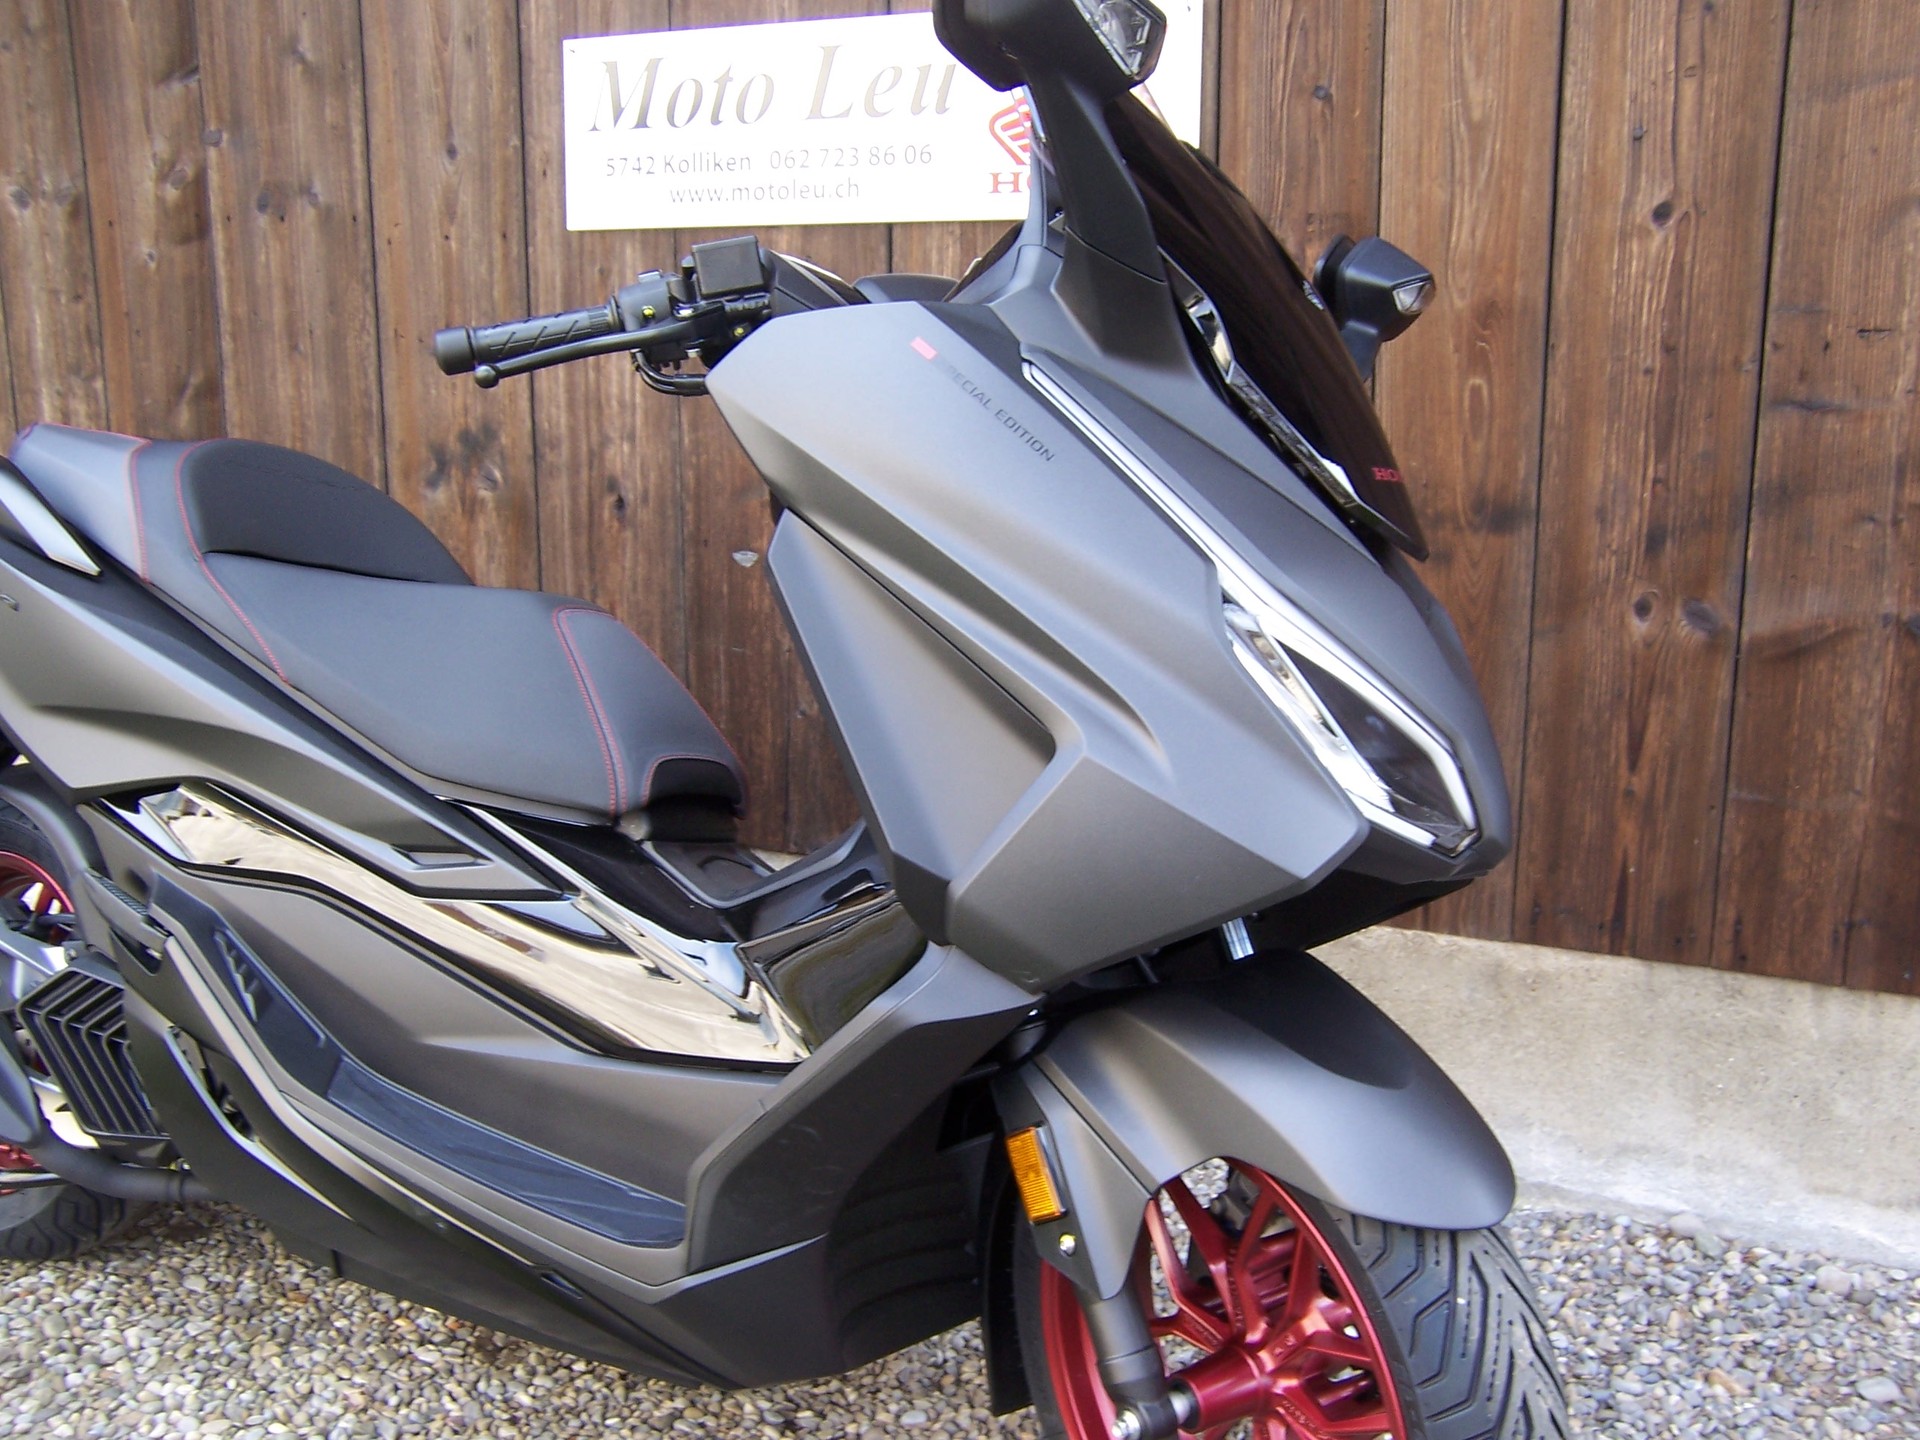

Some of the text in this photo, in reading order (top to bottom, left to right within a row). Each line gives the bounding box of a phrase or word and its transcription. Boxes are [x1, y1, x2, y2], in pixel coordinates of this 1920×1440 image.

[588, 44, 957, 132] Moto Leu
[606, 155, 656, 177] 5742
[770, 149, 810, 170] 062
[819, 147, 859, 167] 723
[869, 145, 896, 166] 86
[904, 144, 932, 164] 06
[669, 176, 860, 203] www.motoleu.ch
[994, 408, 1056, 462] EDITION
